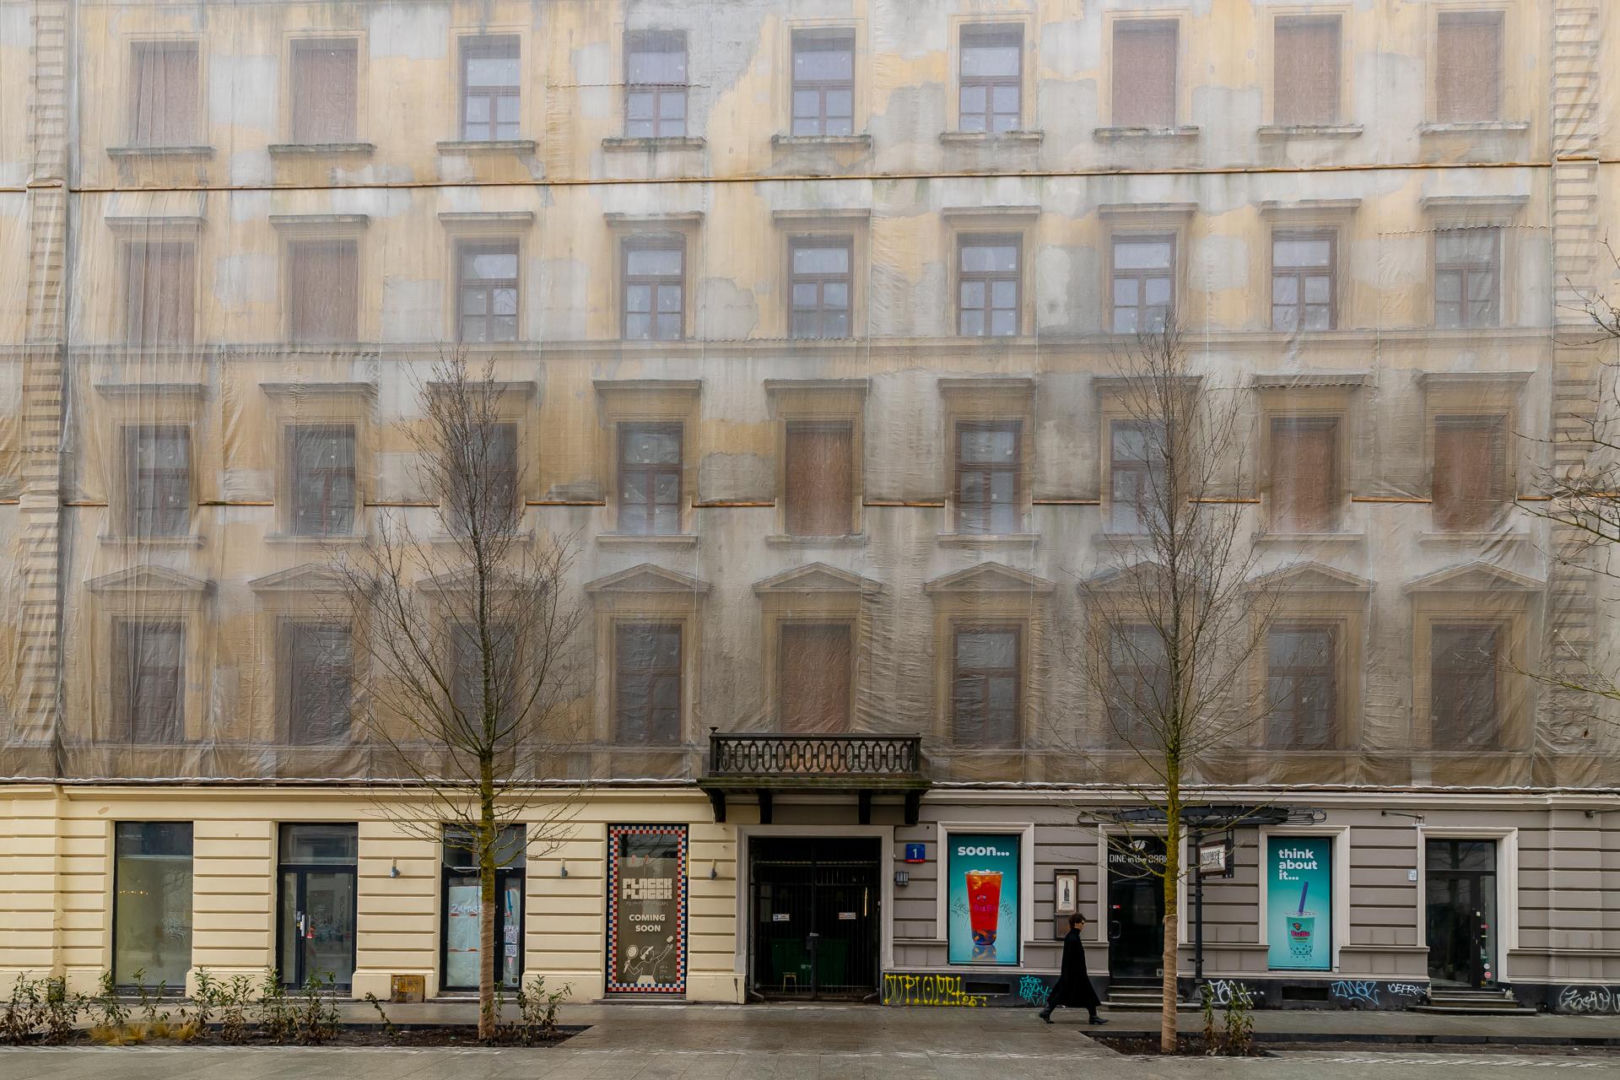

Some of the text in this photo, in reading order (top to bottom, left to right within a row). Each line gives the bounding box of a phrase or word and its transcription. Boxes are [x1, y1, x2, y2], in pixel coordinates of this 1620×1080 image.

[912, 848, 918, 859] 1
[957, 846, 1010, 857] soon...
[1278, 848, 1314, 859] think
[1109, 854, 1127, 863] DINE
[1278, 860, 1318, 870] about
[1279, 870, 1299, 880] it...
[635, 924, 661, 932] SOON
